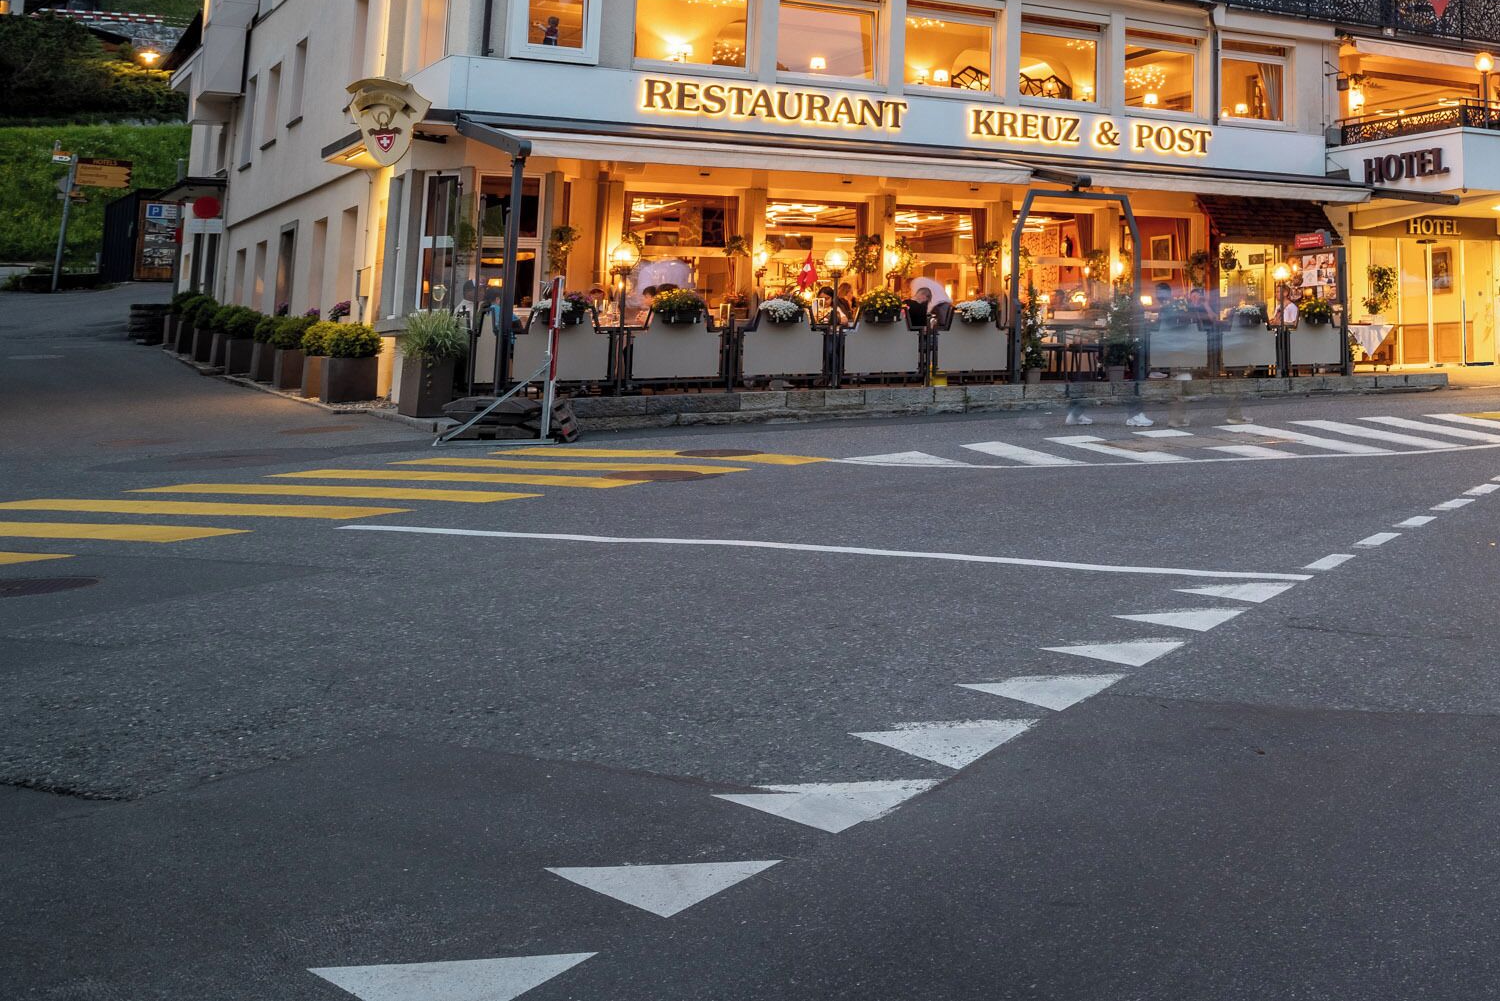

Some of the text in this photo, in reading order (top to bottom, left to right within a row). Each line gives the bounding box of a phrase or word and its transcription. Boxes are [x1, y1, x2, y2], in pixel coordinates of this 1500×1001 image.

[643, 78, 908, 128] RESTAURANT
[971, 109, 1212, 154] KREUZ & POST
[1363, 147, 1449, 185] HOTEL
[1408, 217, 1462, 237] HOTEL
